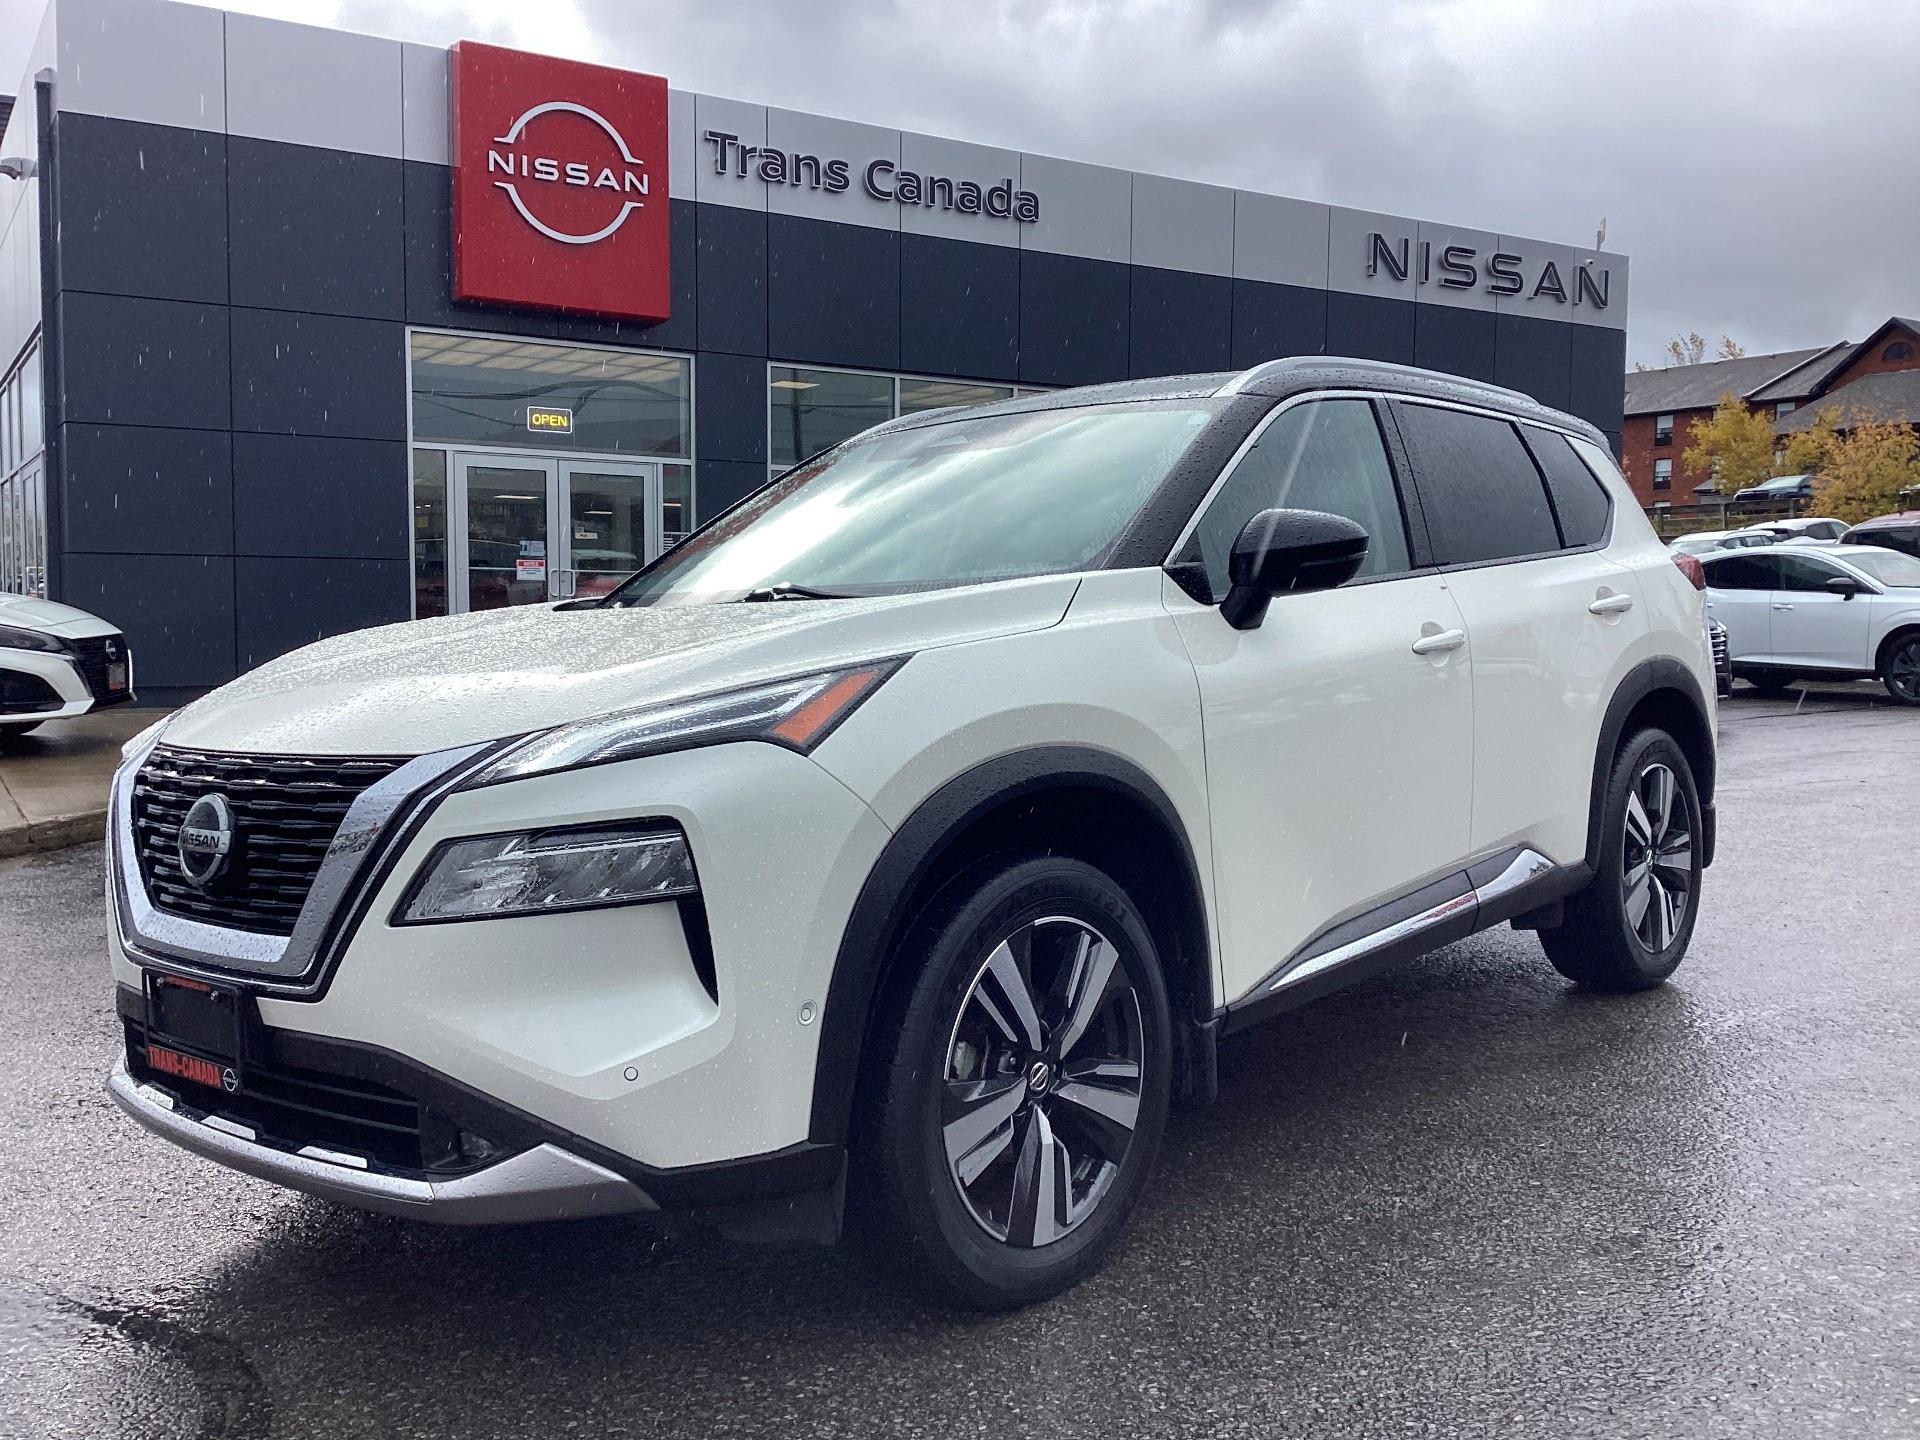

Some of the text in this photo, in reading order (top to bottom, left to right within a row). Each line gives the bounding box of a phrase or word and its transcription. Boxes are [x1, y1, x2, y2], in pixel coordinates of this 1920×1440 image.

[488, 150, 649, 195] NISSAN
[704, 129, 1040, 223] Trans Canada
[1368, 233, 1609, 308] NISSAN
[532, 413, 568, 427] OPEN
[182, 832, 221, 849] NISSAN
[148, 1045, 221, 1088] TRANS-CANADA
